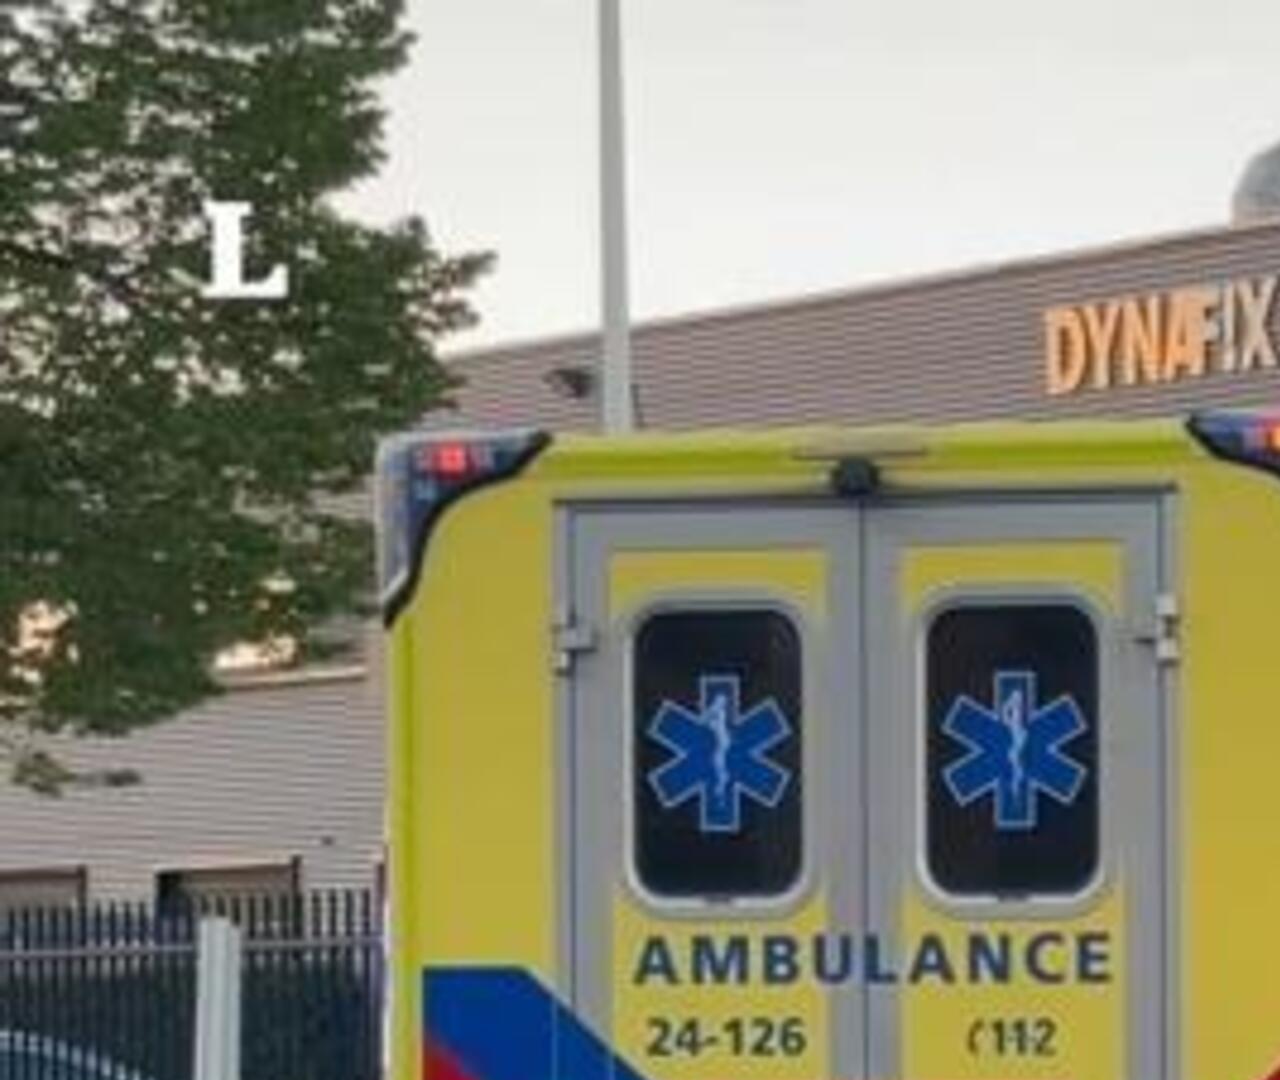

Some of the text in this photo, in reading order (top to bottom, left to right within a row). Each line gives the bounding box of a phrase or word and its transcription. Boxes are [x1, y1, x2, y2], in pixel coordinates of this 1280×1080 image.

[1045, 276, 1278, 395] DYNAFIX
[633, 932, 1113, 985] AMBULANCE
[645, 1017, 807, 1057] 24-126
